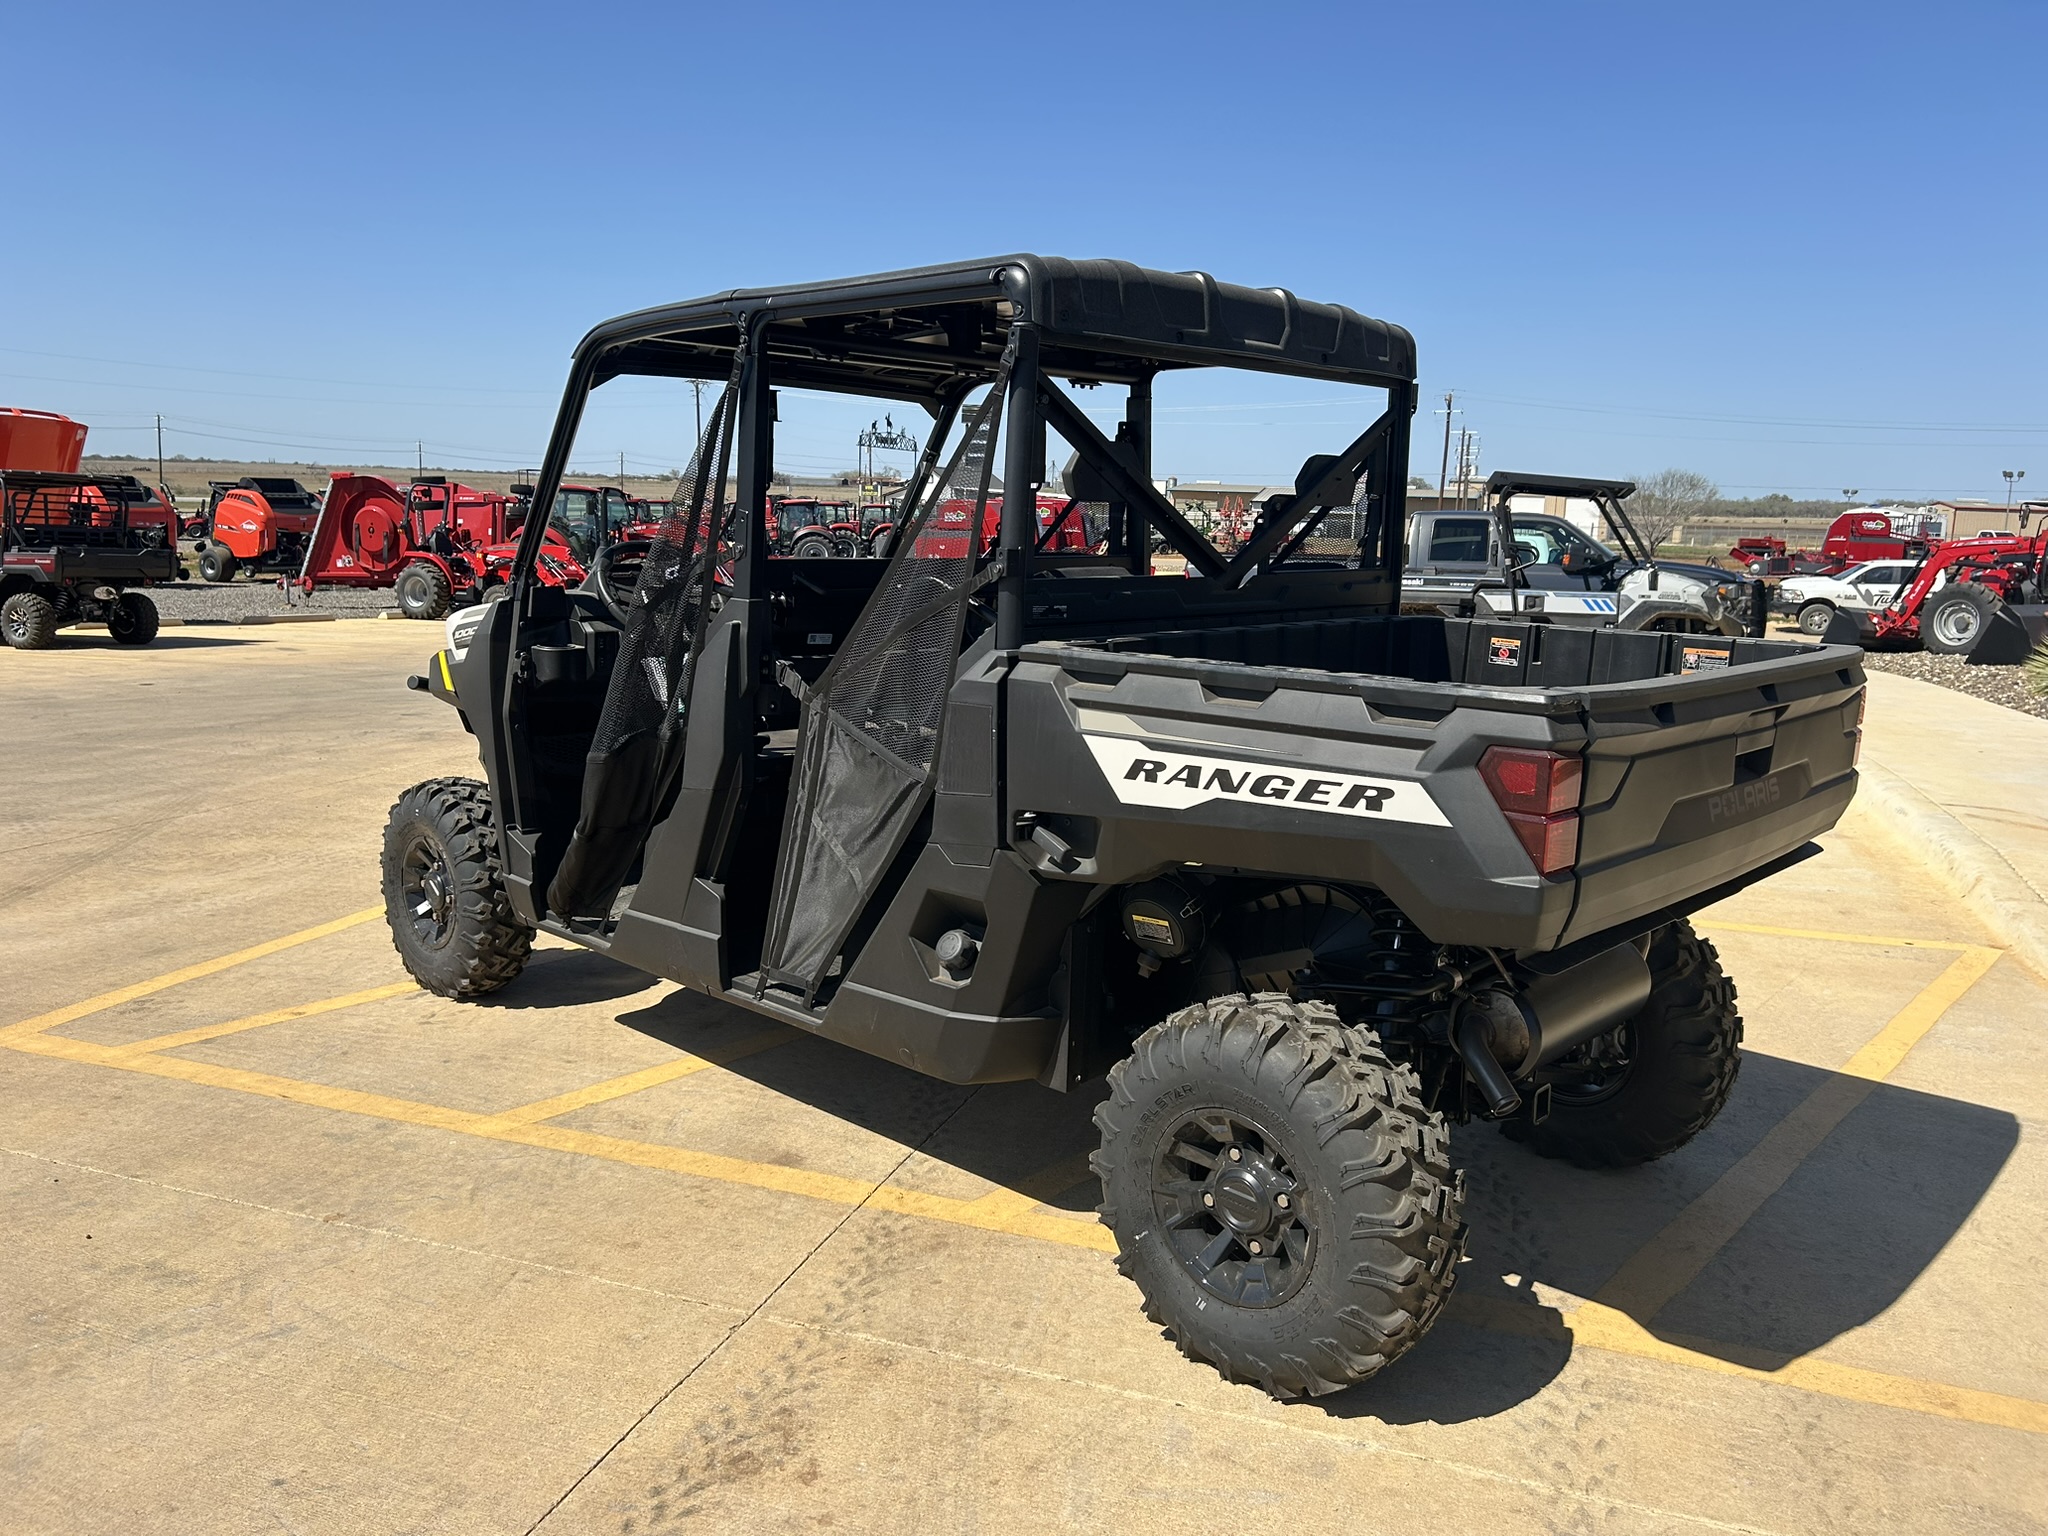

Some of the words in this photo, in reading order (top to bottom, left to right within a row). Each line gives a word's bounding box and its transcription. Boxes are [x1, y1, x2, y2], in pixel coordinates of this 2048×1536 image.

[1123, 758, 1396, 812] RANGER
[1708, 777, 1780, 823] POLARIS
[1131, 1083, 1194, 1147] CARLSTAR
